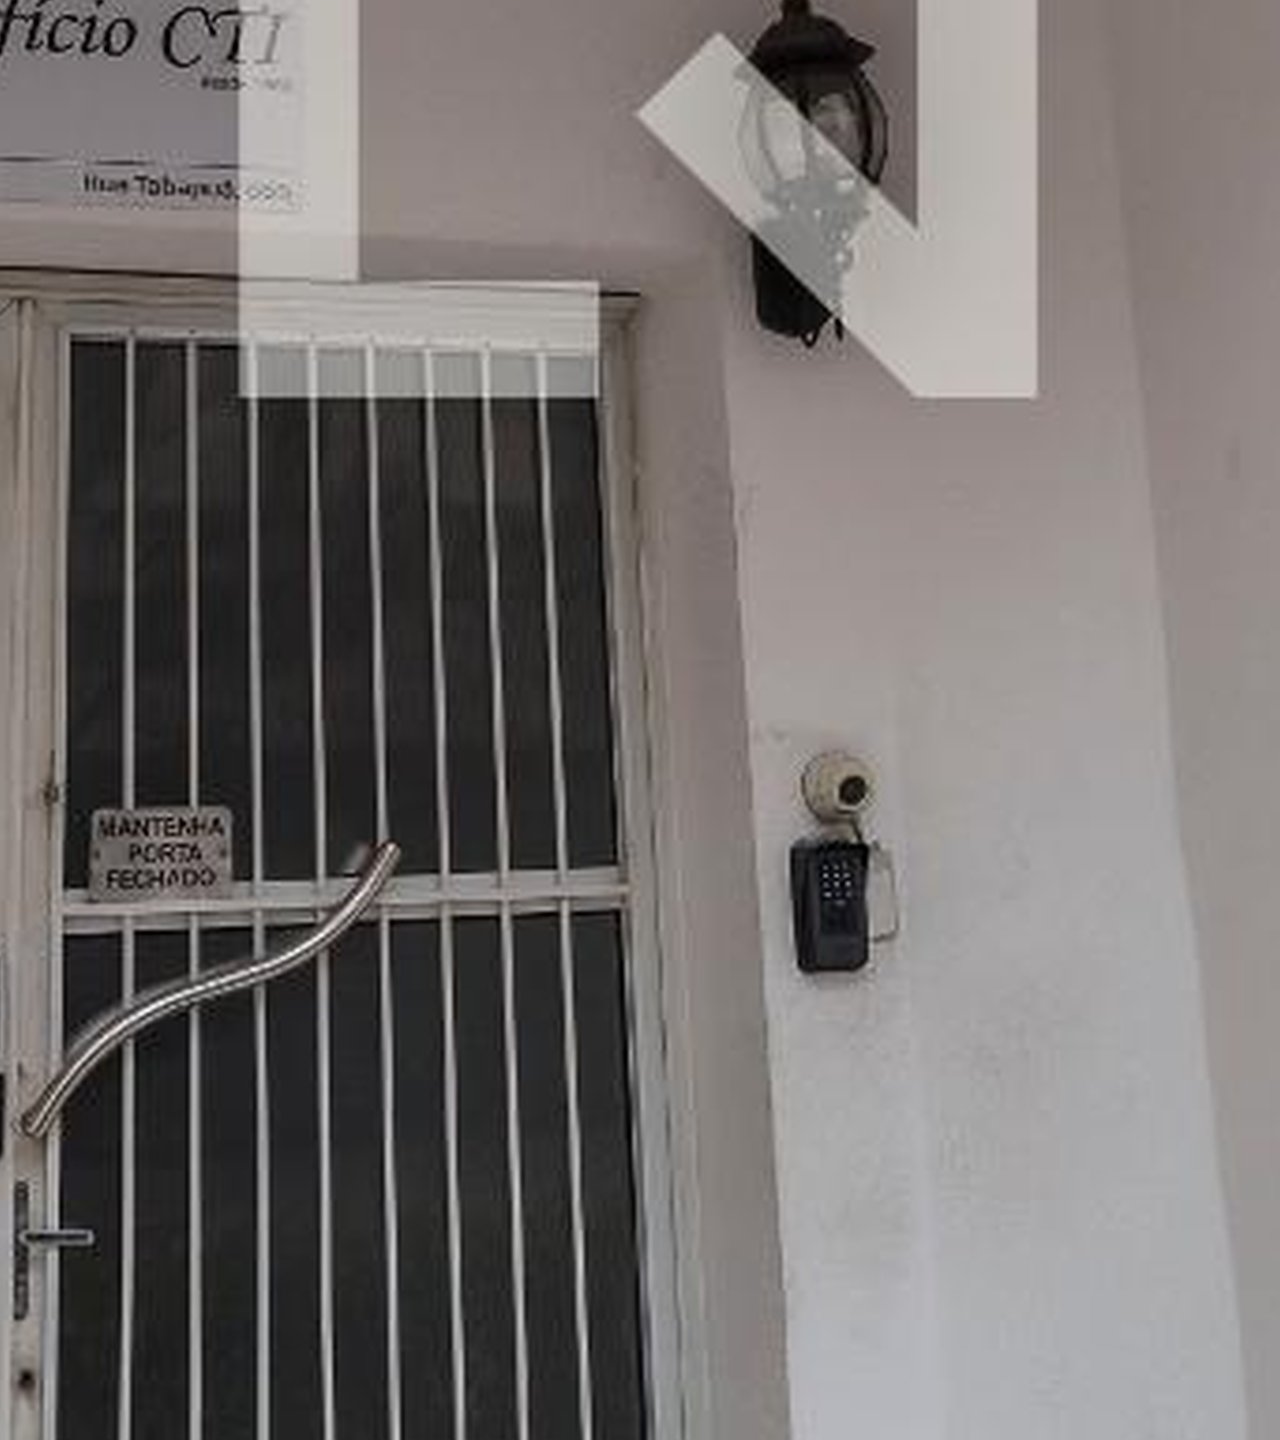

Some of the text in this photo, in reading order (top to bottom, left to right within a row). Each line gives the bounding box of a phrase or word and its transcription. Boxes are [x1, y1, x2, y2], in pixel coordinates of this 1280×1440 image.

[161, 4, 292, 69] CTI
[99, 816, 224, 837] MANTENHA
[129, 843, 202, 863] PORTA
[107, 868, 217, 890] FECHADO
